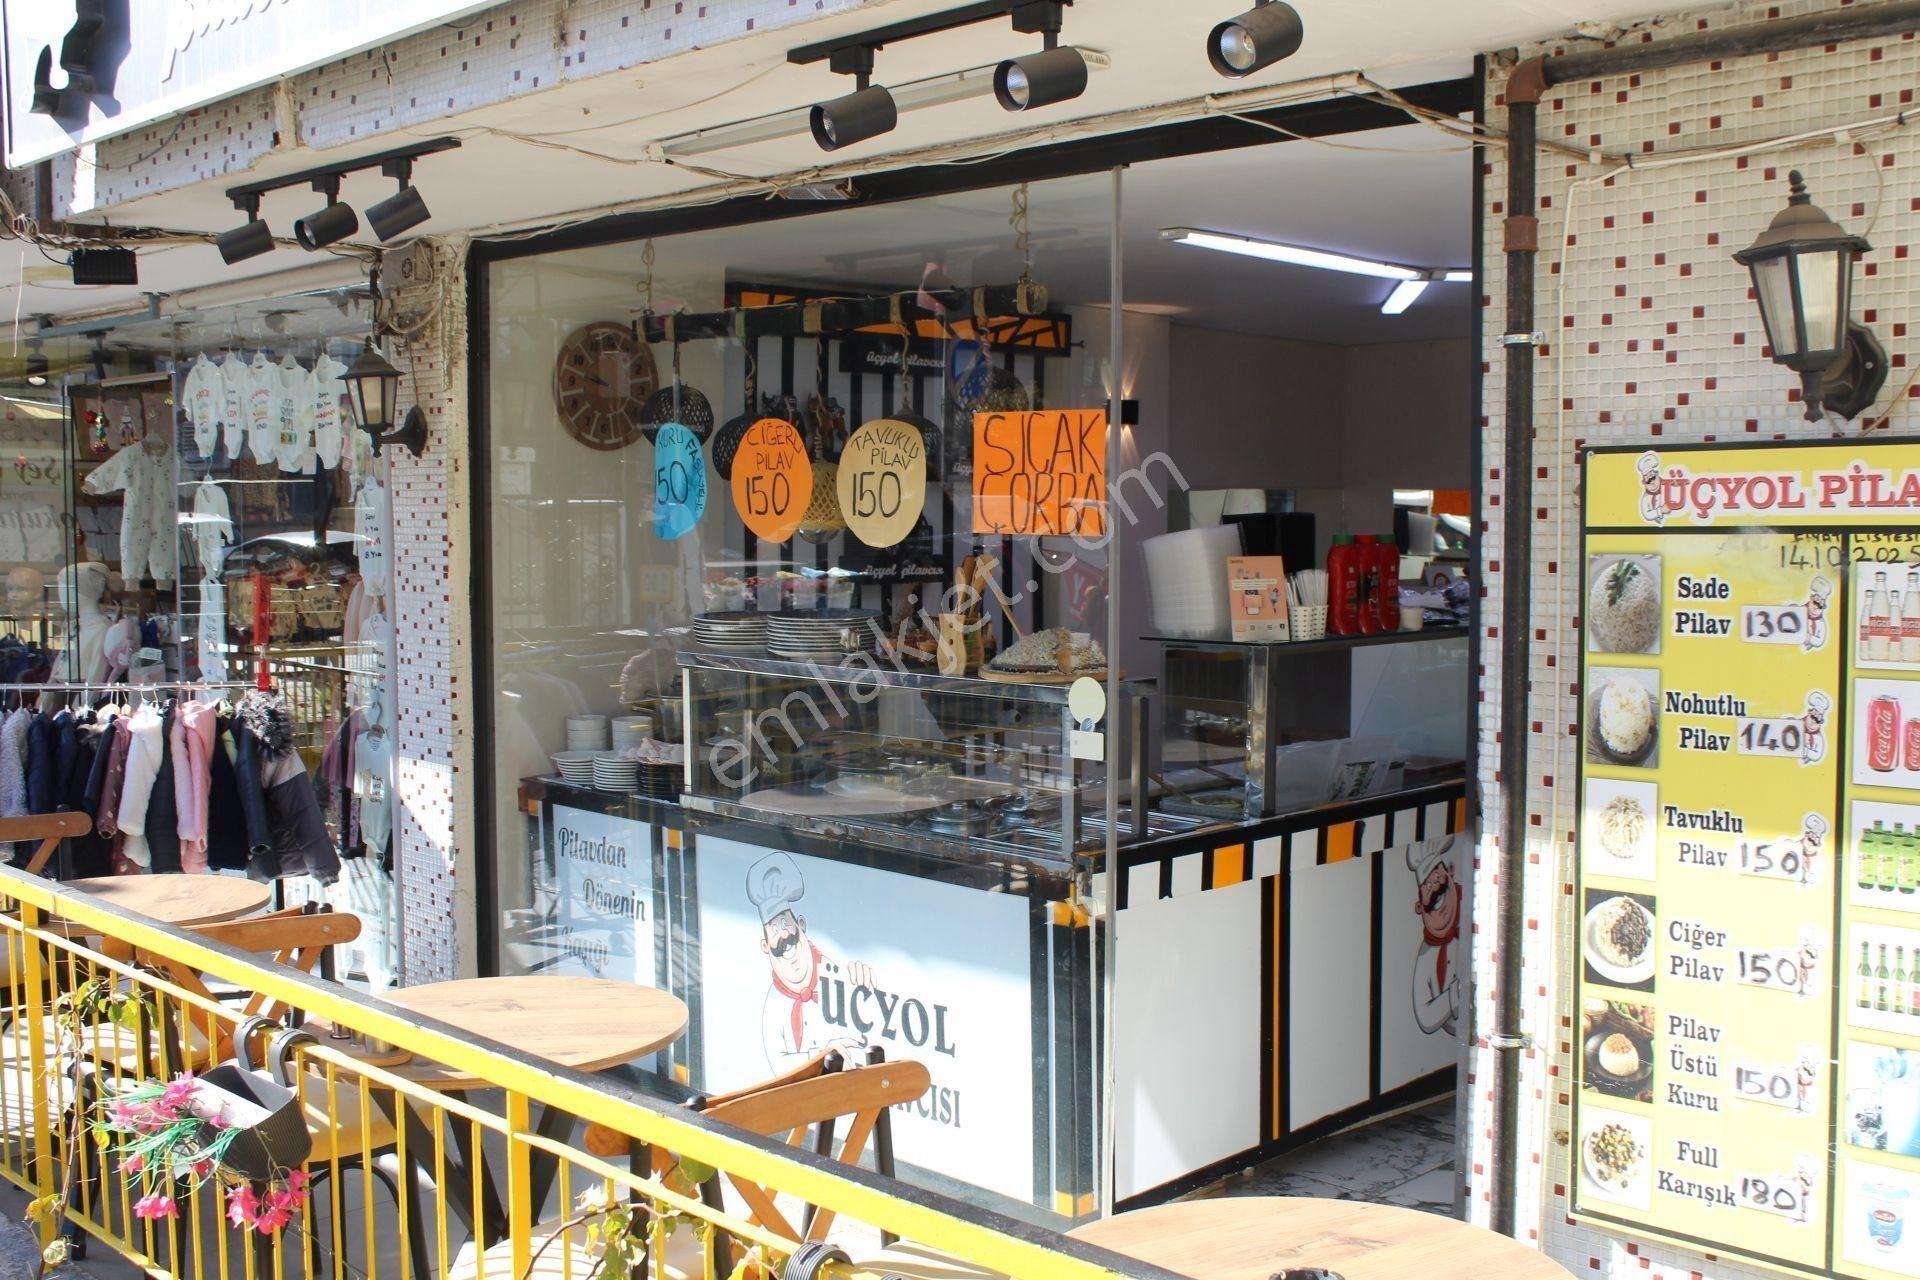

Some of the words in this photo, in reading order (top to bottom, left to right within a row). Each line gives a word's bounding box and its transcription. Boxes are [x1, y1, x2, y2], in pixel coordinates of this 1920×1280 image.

[983, 412, 1102, 475] SICAK
[746, 472, 791, 516] 150
[852, 471, 902, 518] 150
[979, 472, 1104, 535] ÇORBA
[1661, 469, 1805, 519] ÜÇYOL
[1677, 577, 1730, 599] Sade
[1675, 612, 1732, 635] Pilav
[1746, 610, 1802, 638] 130
[1665, 691, 1746, 717] Nohutlu
[1679, 727, 1731, 752] Pilav
[1741, 722, 1800, 752] 140
[1664, 805, 1744, 834] Tavuklu
[558, 827, 627, 868] Pilavdan
[1678, 842, 1728, 867] Pilav
[1740, 842, 1800, 875] 150
[583, 878, 646, 922] Dönenin
[1669, 920, 1727, 951] Ciğer
[1669, 954, 1725, 983] Pilav
[1739, 951, 1798, 986] 150
[819, 962, 956, 1059] ÜÇYOL
[1668, 1015, 1721, 1043] Pilav
[1670, 1043, 1719, 1078] Üstü
[1736, 1066, 1792, 1100] 150
[1667, 1083, 1719, 1112] Kuru
[1676, 1140, 1719, 1169] Full
[1657, 1169, 1737, 1208] Karışık
